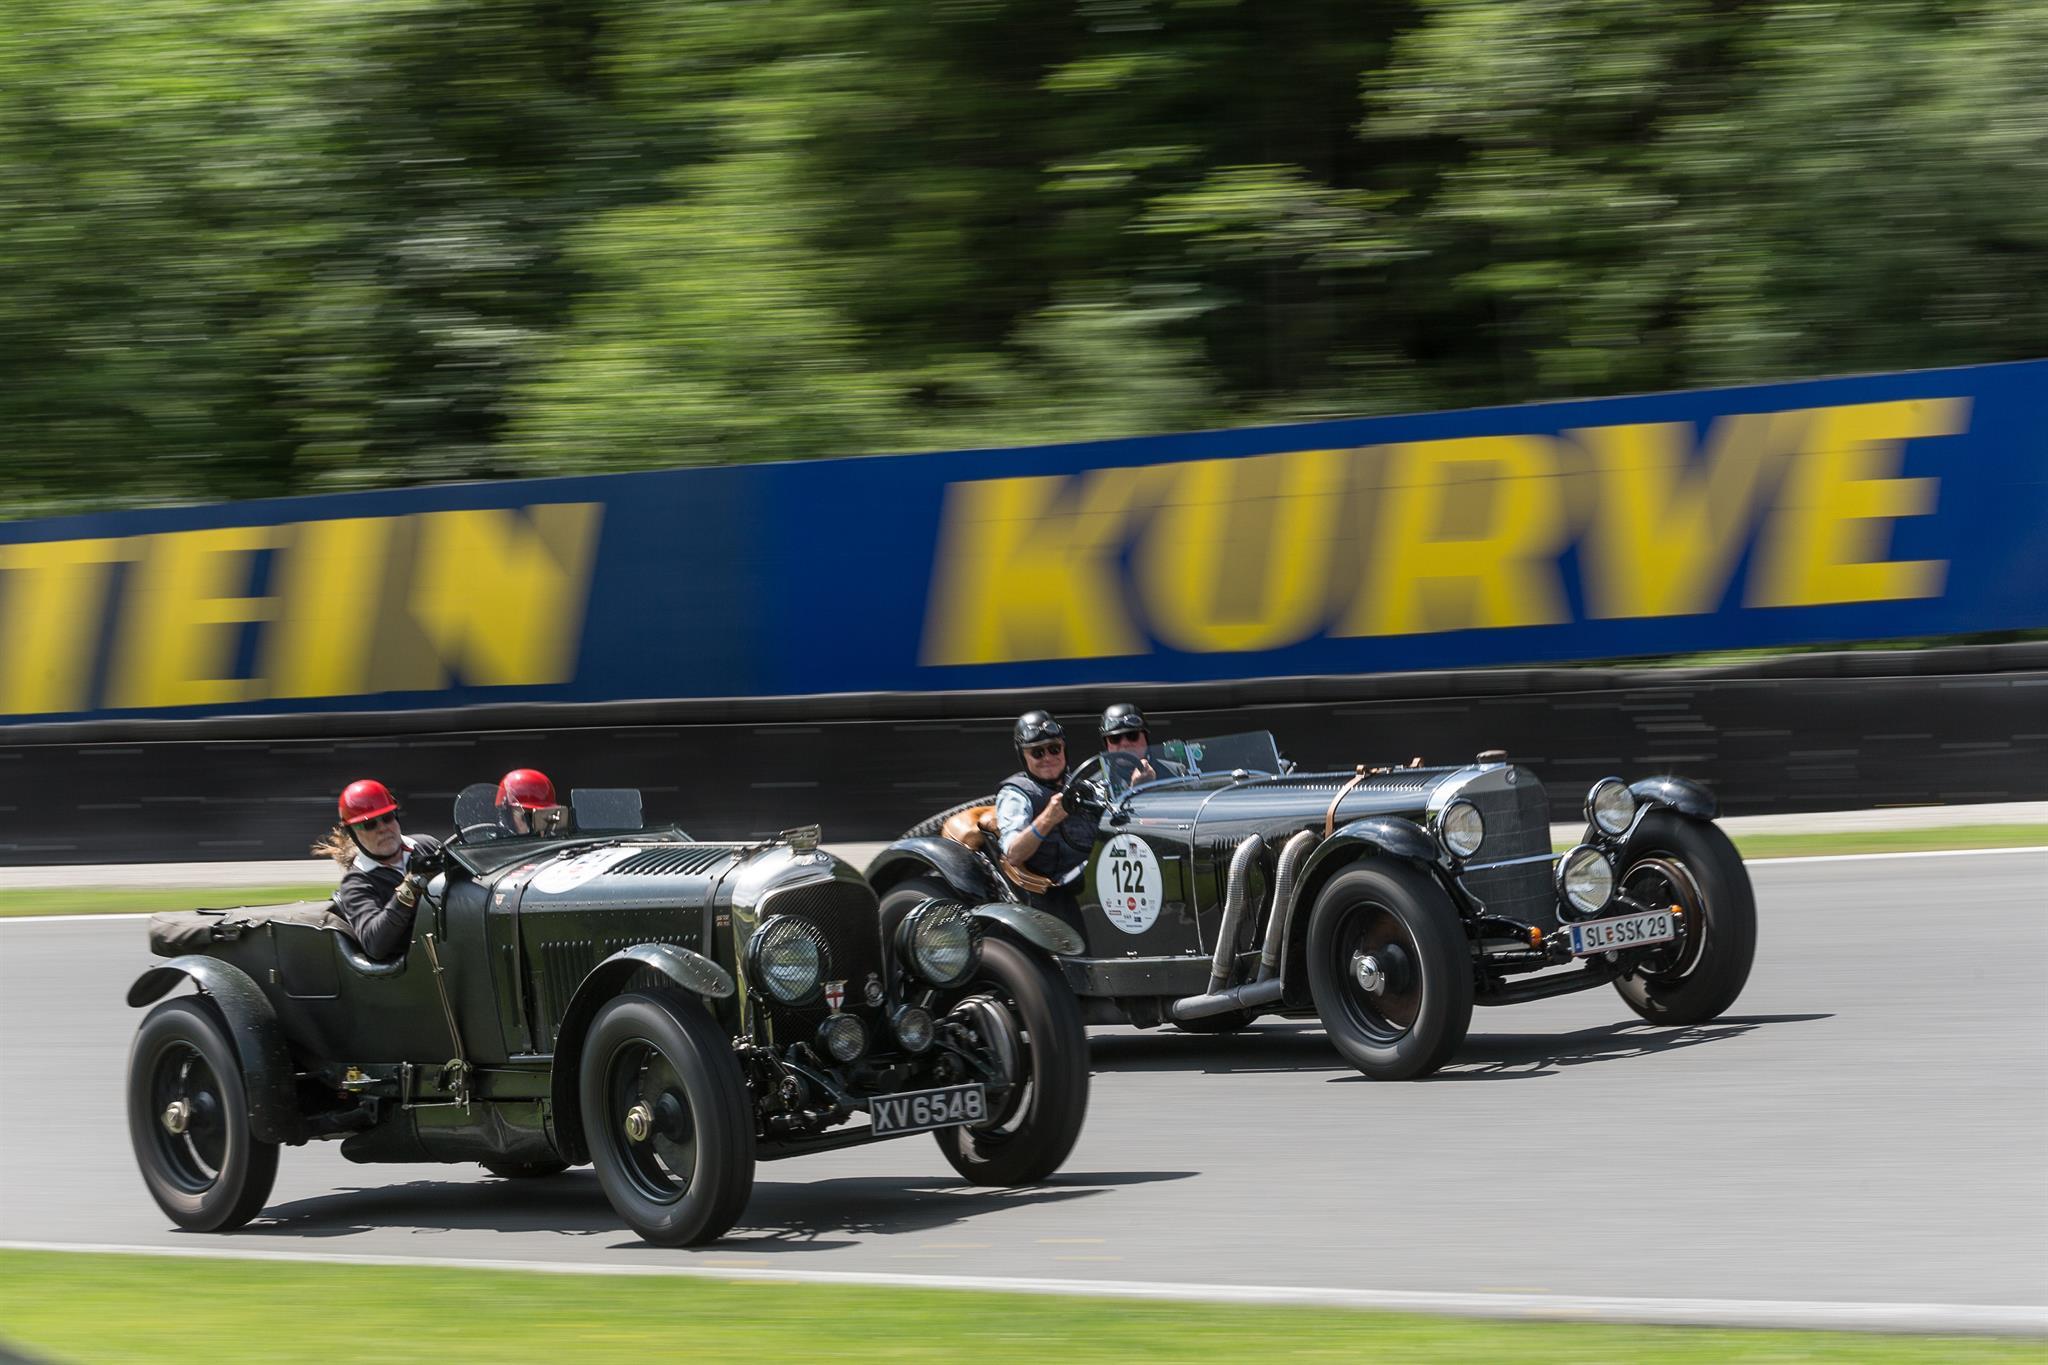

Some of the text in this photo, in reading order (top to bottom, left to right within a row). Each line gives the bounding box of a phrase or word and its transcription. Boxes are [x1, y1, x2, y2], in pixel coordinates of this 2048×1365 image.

[918, 396, 1973, 668] KURVE
[1112, 860, 1145, 893] 122
[1586, 927, 1605, 948] SL
